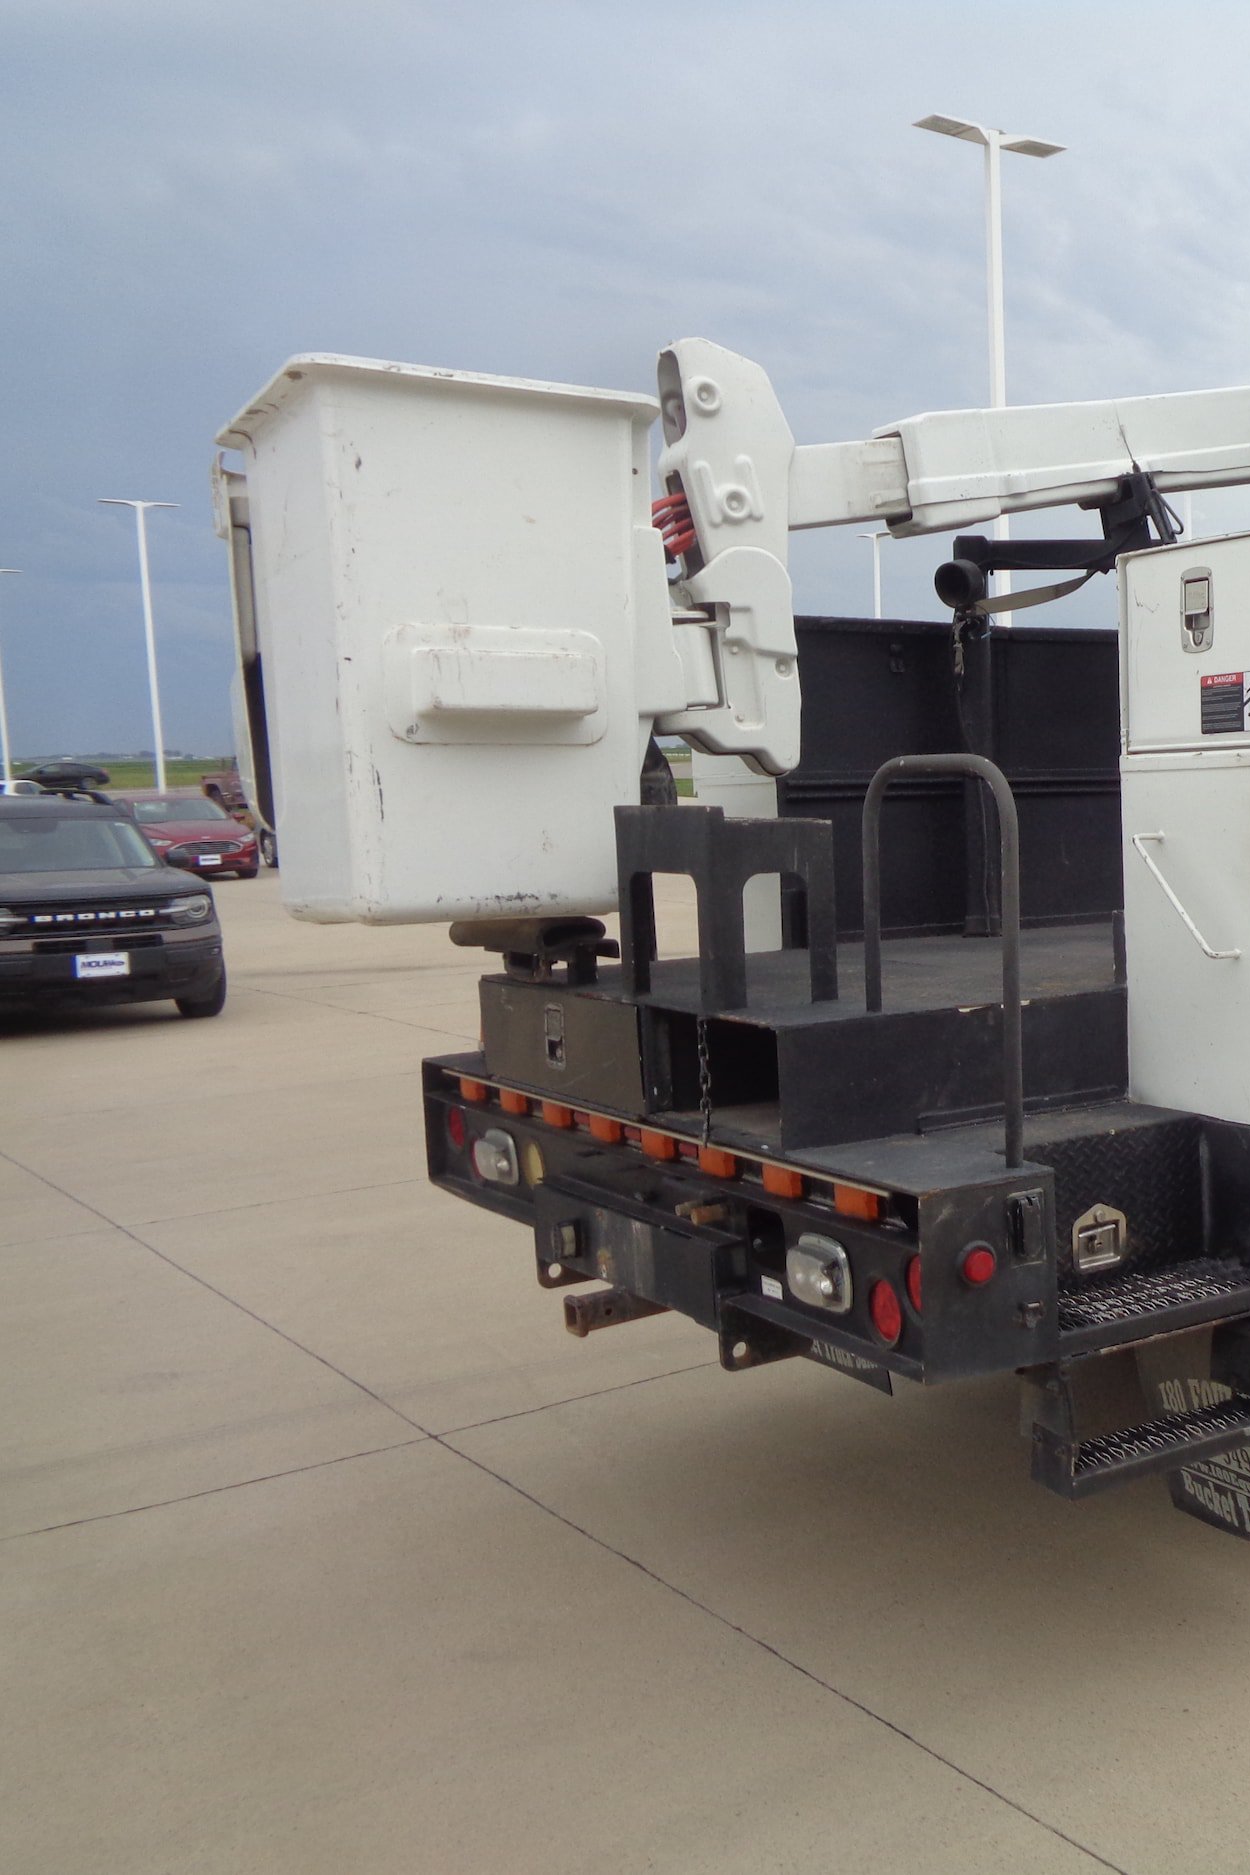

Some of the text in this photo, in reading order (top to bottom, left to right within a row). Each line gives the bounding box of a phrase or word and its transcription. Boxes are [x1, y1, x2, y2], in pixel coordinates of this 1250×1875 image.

[1213, 674, 1237, 684] DANGER
[33, 908, 156, 924] BRONCO
[1180, 1469, 1239, 1527] Bucket
